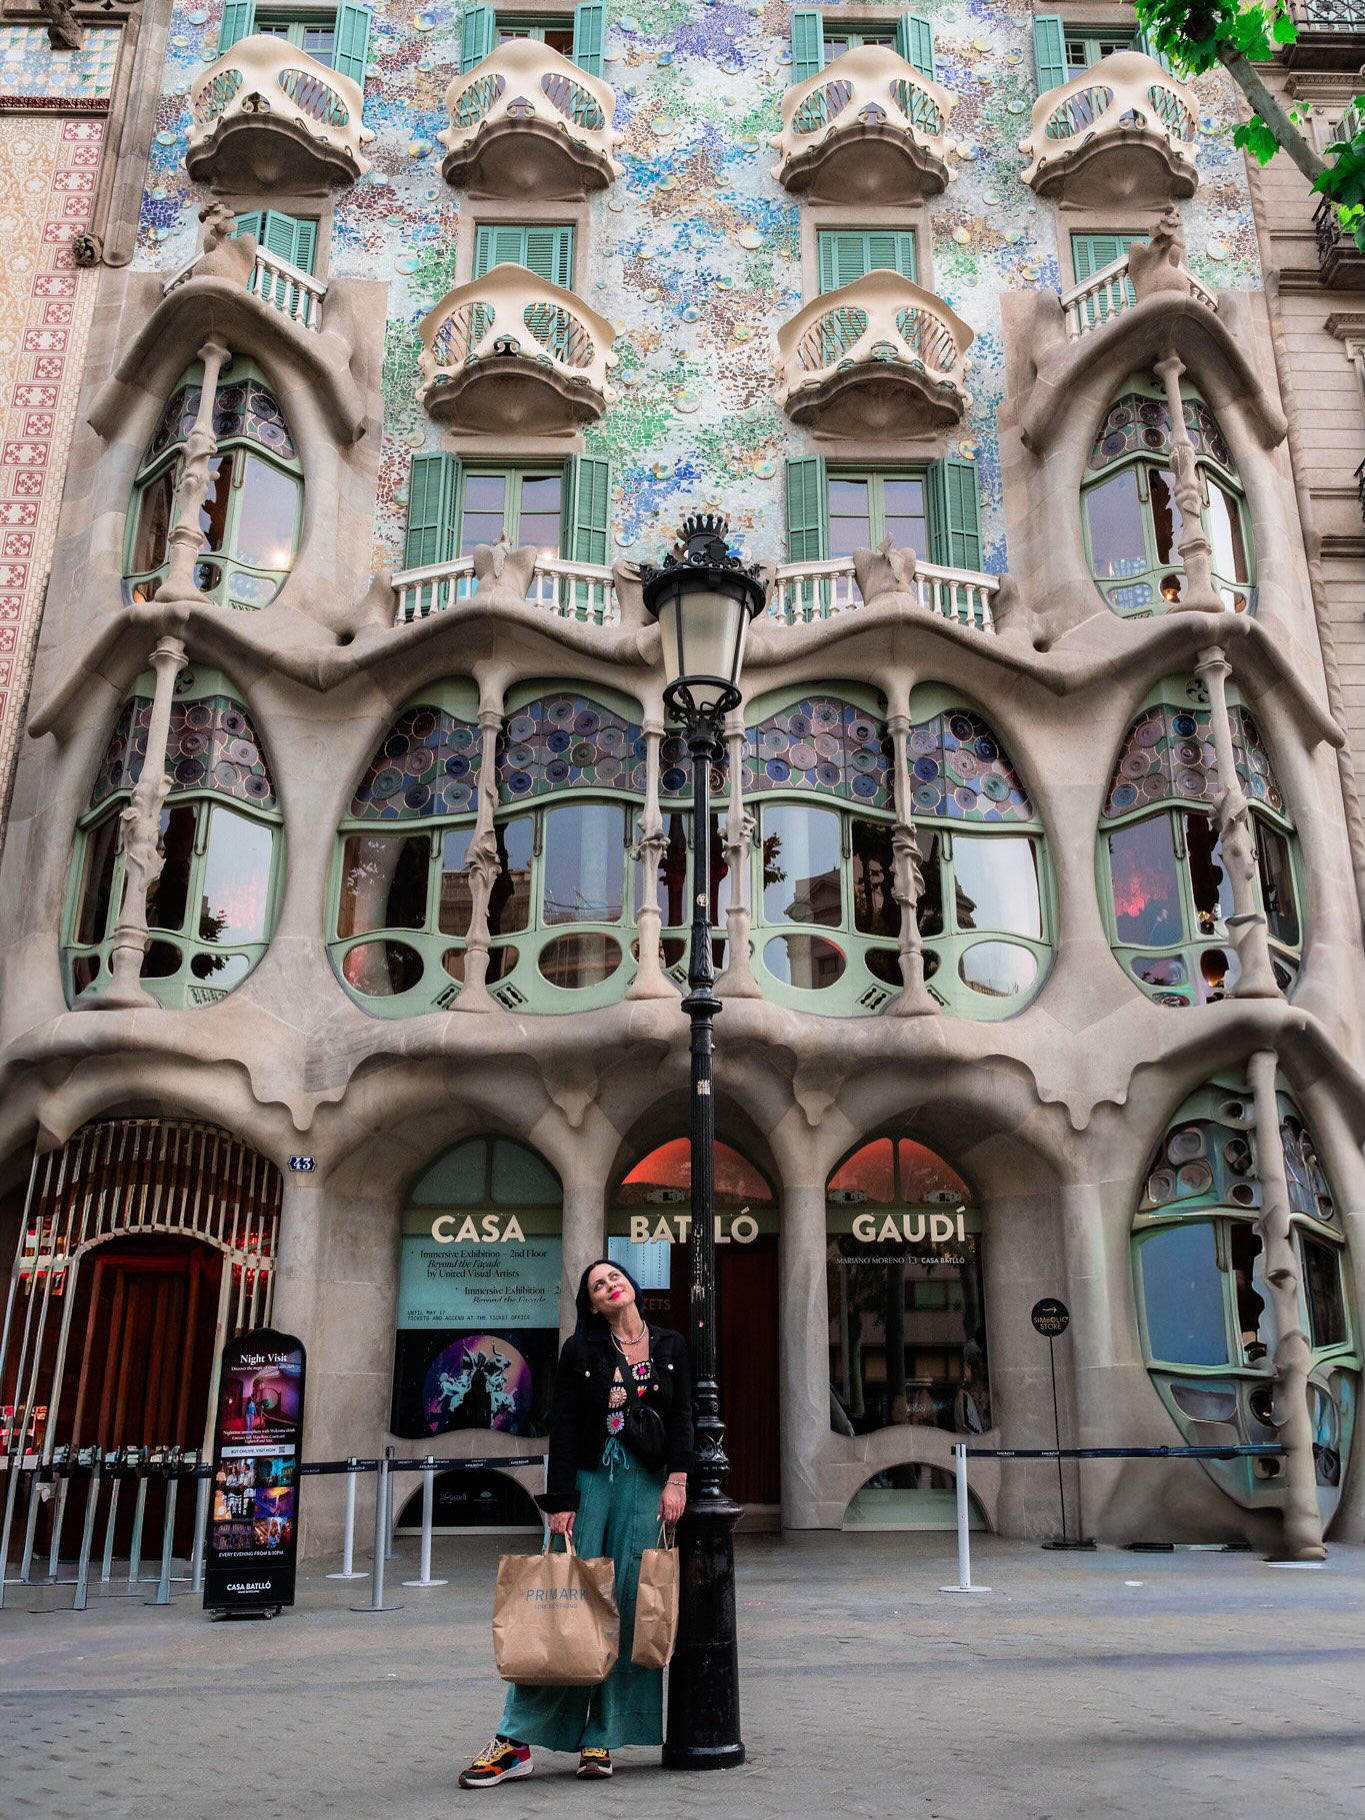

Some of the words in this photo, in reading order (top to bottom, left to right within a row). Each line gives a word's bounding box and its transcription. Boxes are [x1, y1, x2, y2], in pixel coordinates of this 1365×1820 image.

[293, 1157, 311, 1170] 43
[431, 1214, 526, 1243] CASA
[630, 1206, 759, 1244] BATLÓ
[852, 1205, 966, 1243] GAUDÍ
[420, 1250, 459, 1258] Immersive
[460, 1249, 501, 1258] Exhibition
[510, 1249, 525, 1258] 2nd
[526, 1249, 548, 1258] Floor
[458, 1259, 471, 1268] the
[427, 1269, 437, 1280] by
[439, 1269, 466, 1278] United
[467, 1269, 492, 1278] Visual
[495, 1270, 520, 1278] Artists
[465, 1287, 504, 1295] Immersive
[505, 1286, 545, 1295] Exhibition
[240, 1353, 265, 1366] Night
[267, 1352, 288, 1363] Visit
[227, 1583, 245, 1591] CASA
[246, 1581, 272, 1590] BATLLÓ
